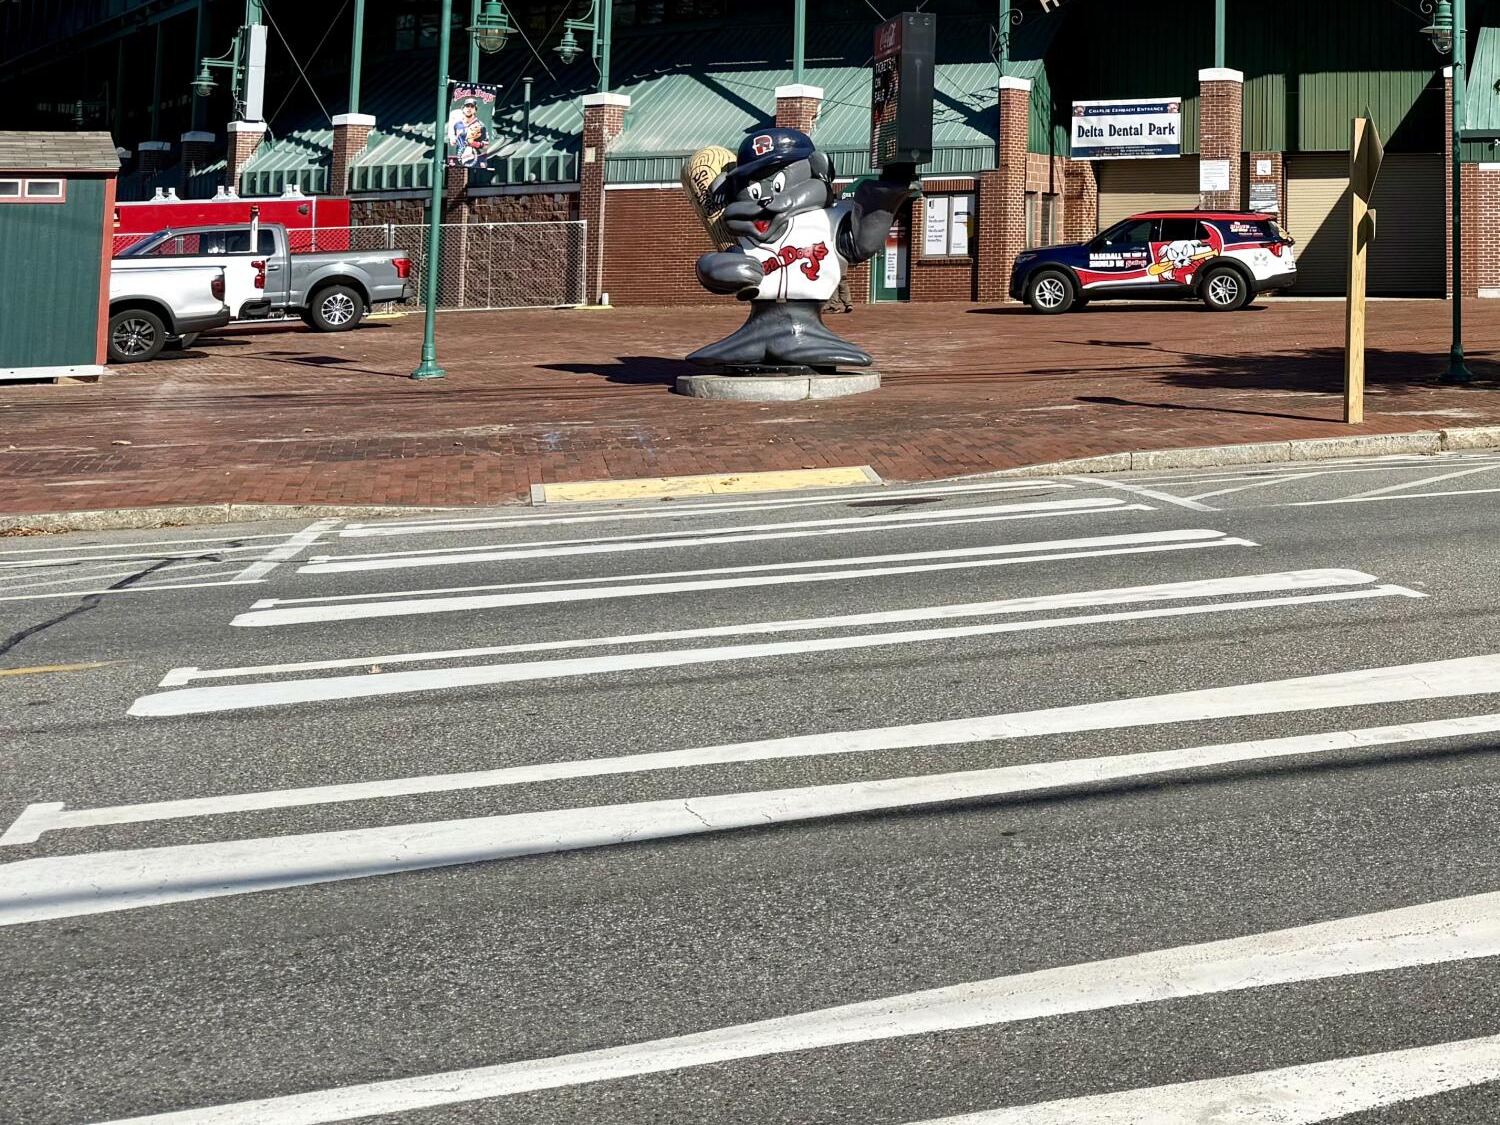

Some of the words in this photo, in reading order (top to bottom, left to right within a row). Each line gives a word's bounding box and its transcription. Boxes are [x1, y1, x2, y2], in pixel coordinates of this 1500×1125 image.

[1077, 124, 1104, 138] Delta
[1108, 123, 1143, 137] Dental
[1148, 122, 1175, 135] Park
[762, 257, 780, 276] ea
[779, 241, 829, 281] Dogs
